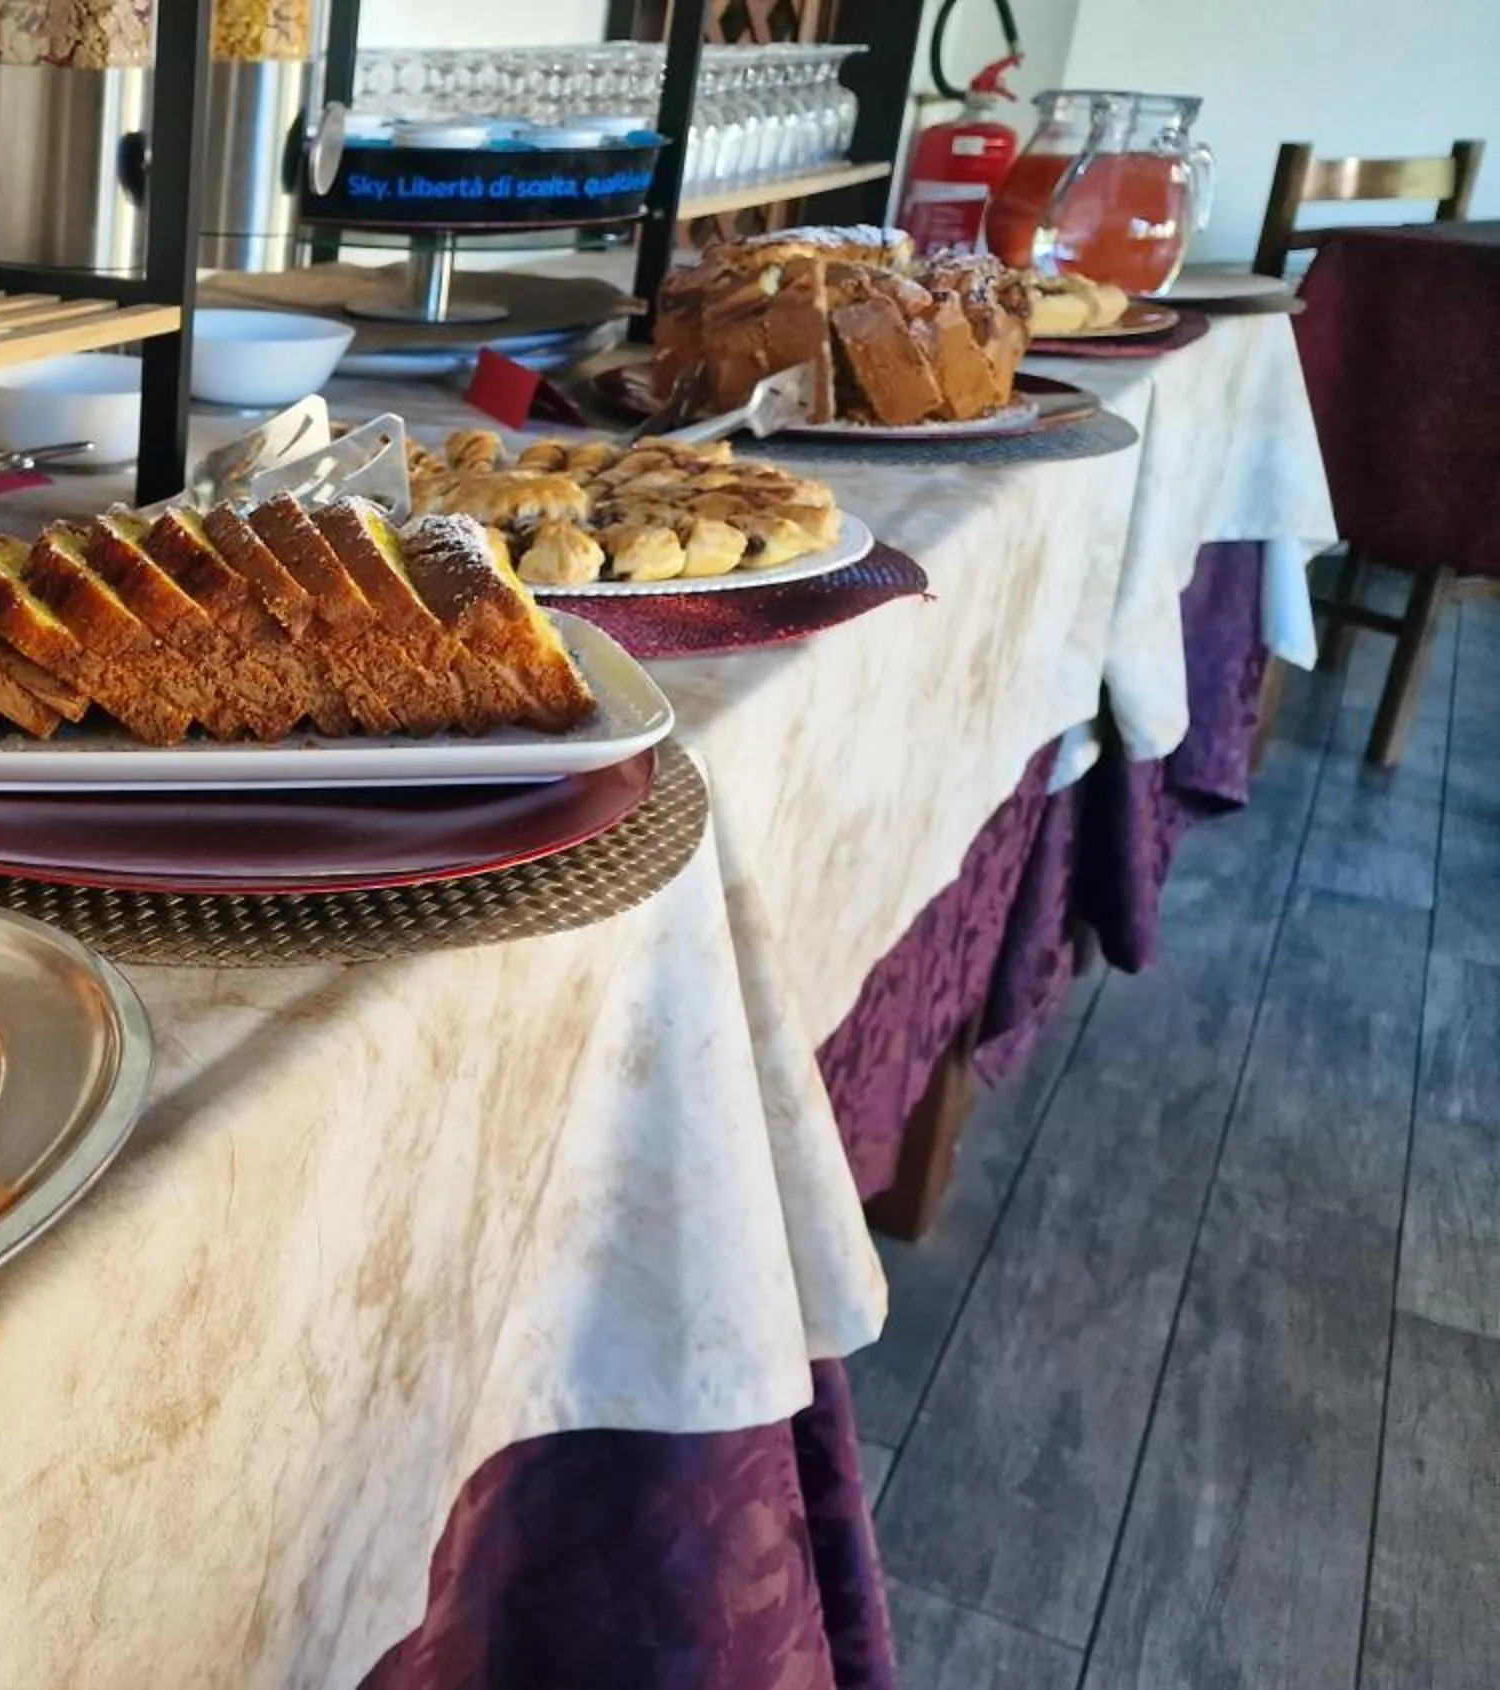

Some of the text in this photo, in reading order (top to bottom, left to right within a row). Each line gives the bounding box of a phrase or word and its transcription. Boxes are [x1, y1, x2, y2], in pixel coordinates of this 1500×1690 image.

[348, 175, 391, 201] Sky.
[398, 174, 483, 197] Libertà
[489, 175, 512, 197] di
